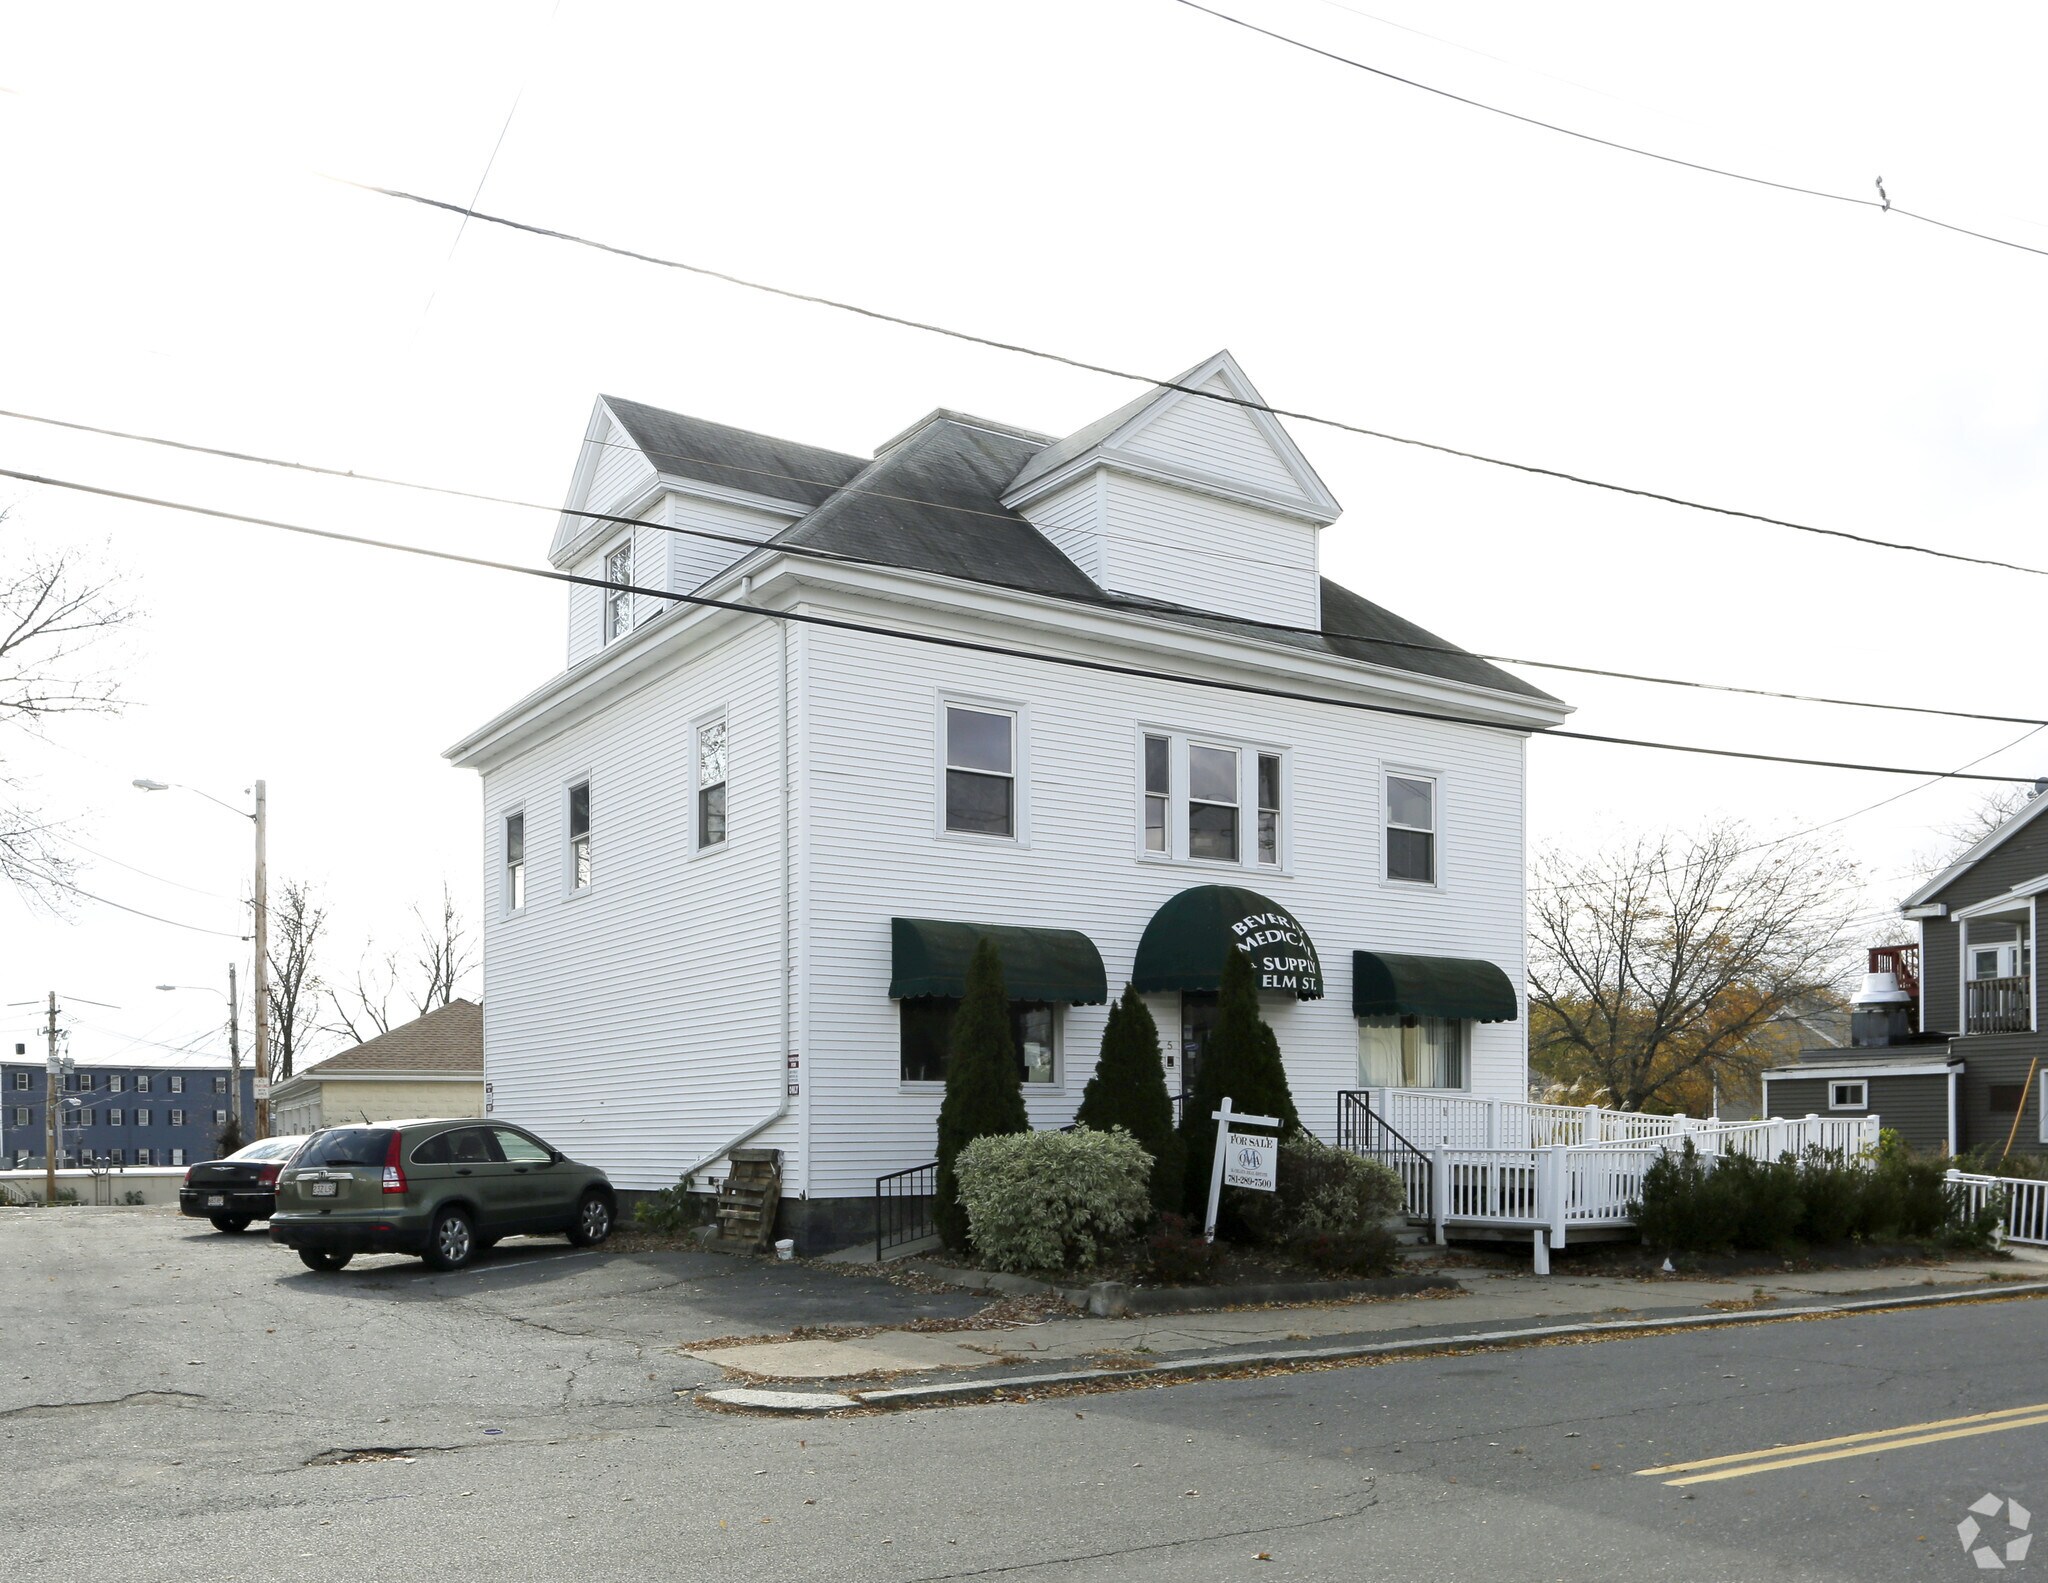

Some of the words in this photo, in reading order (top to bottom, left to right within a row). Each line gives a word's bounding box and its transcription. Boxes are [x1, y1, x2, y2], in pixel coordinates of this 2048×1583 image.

[1262, 956, 1316, 974] SUPPLY
[1262, 974, 1297, 989] ELM
[1302, 976, 1317, 991] ST.
[1230, 1135, 1248, 1146] FOR
[1249, 1138, 1273, 1149] SALE
